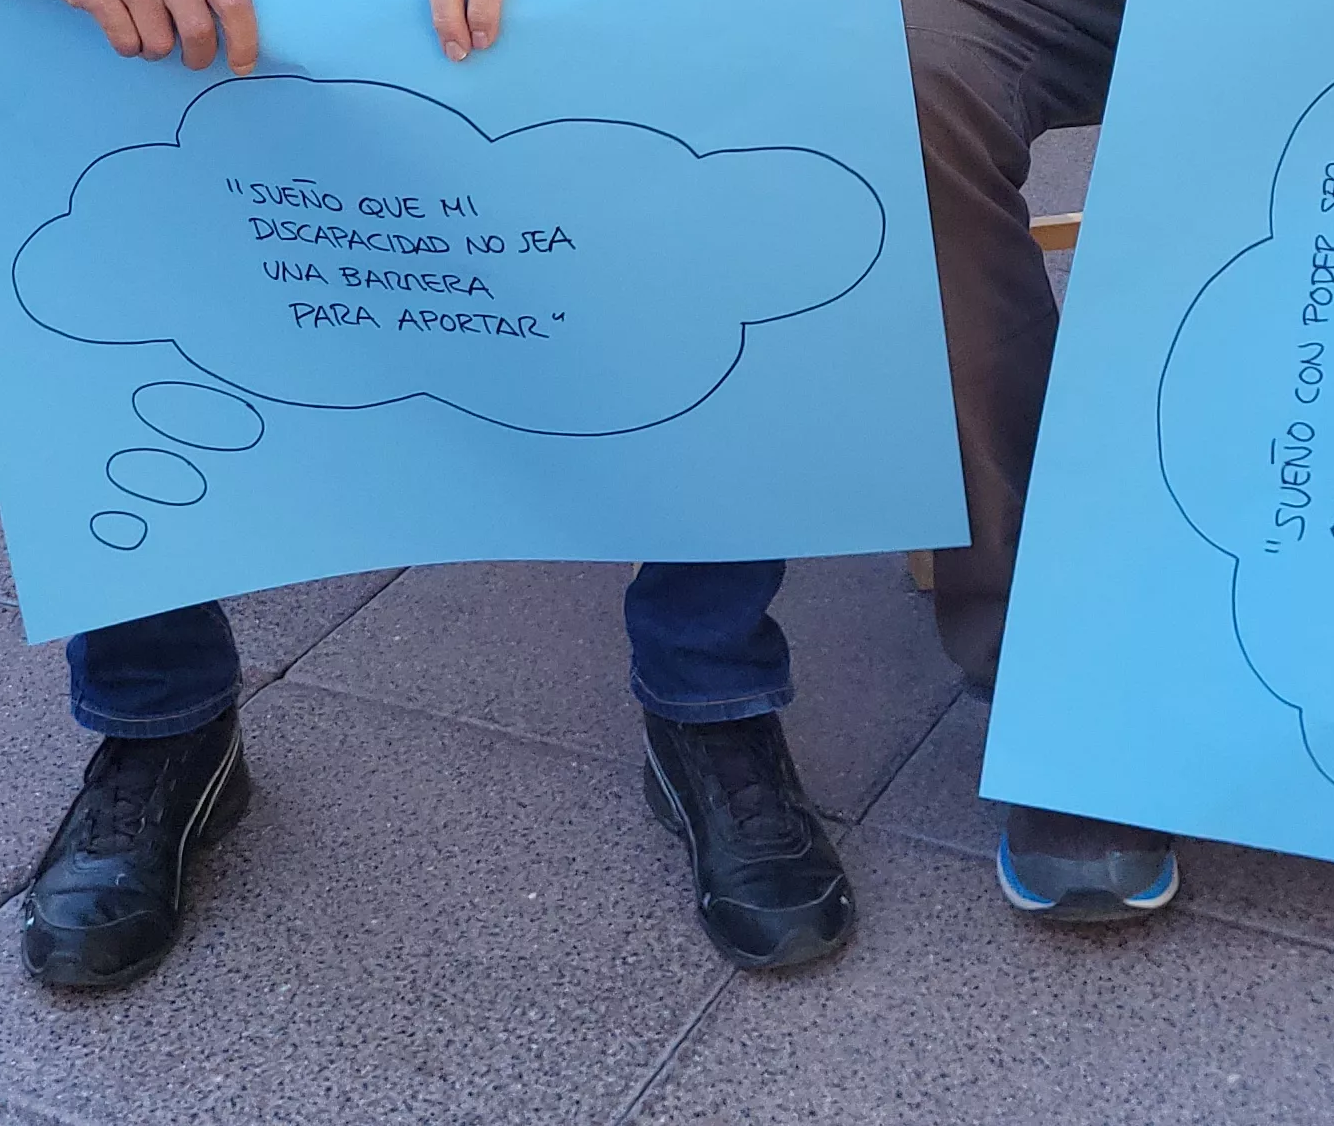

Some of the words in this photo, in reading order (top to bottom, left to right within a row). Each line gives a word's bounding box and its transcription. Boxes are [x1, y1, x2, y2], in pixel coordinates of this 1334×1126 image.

[358, 196, 426, 219] QUE
[440, 194, 479, 217] MI
[248, 216, 451, 254] DISCAPACIDAD
[465, 233, 506, 255] NO
[517, 225, 577, 254] SEA
[262, 259, 329, 285] UNA
[339, 265, 496, 301] BARRERA
[288, 301, 382, 330] PARA
[1294, 341, 1325, 405] CON
